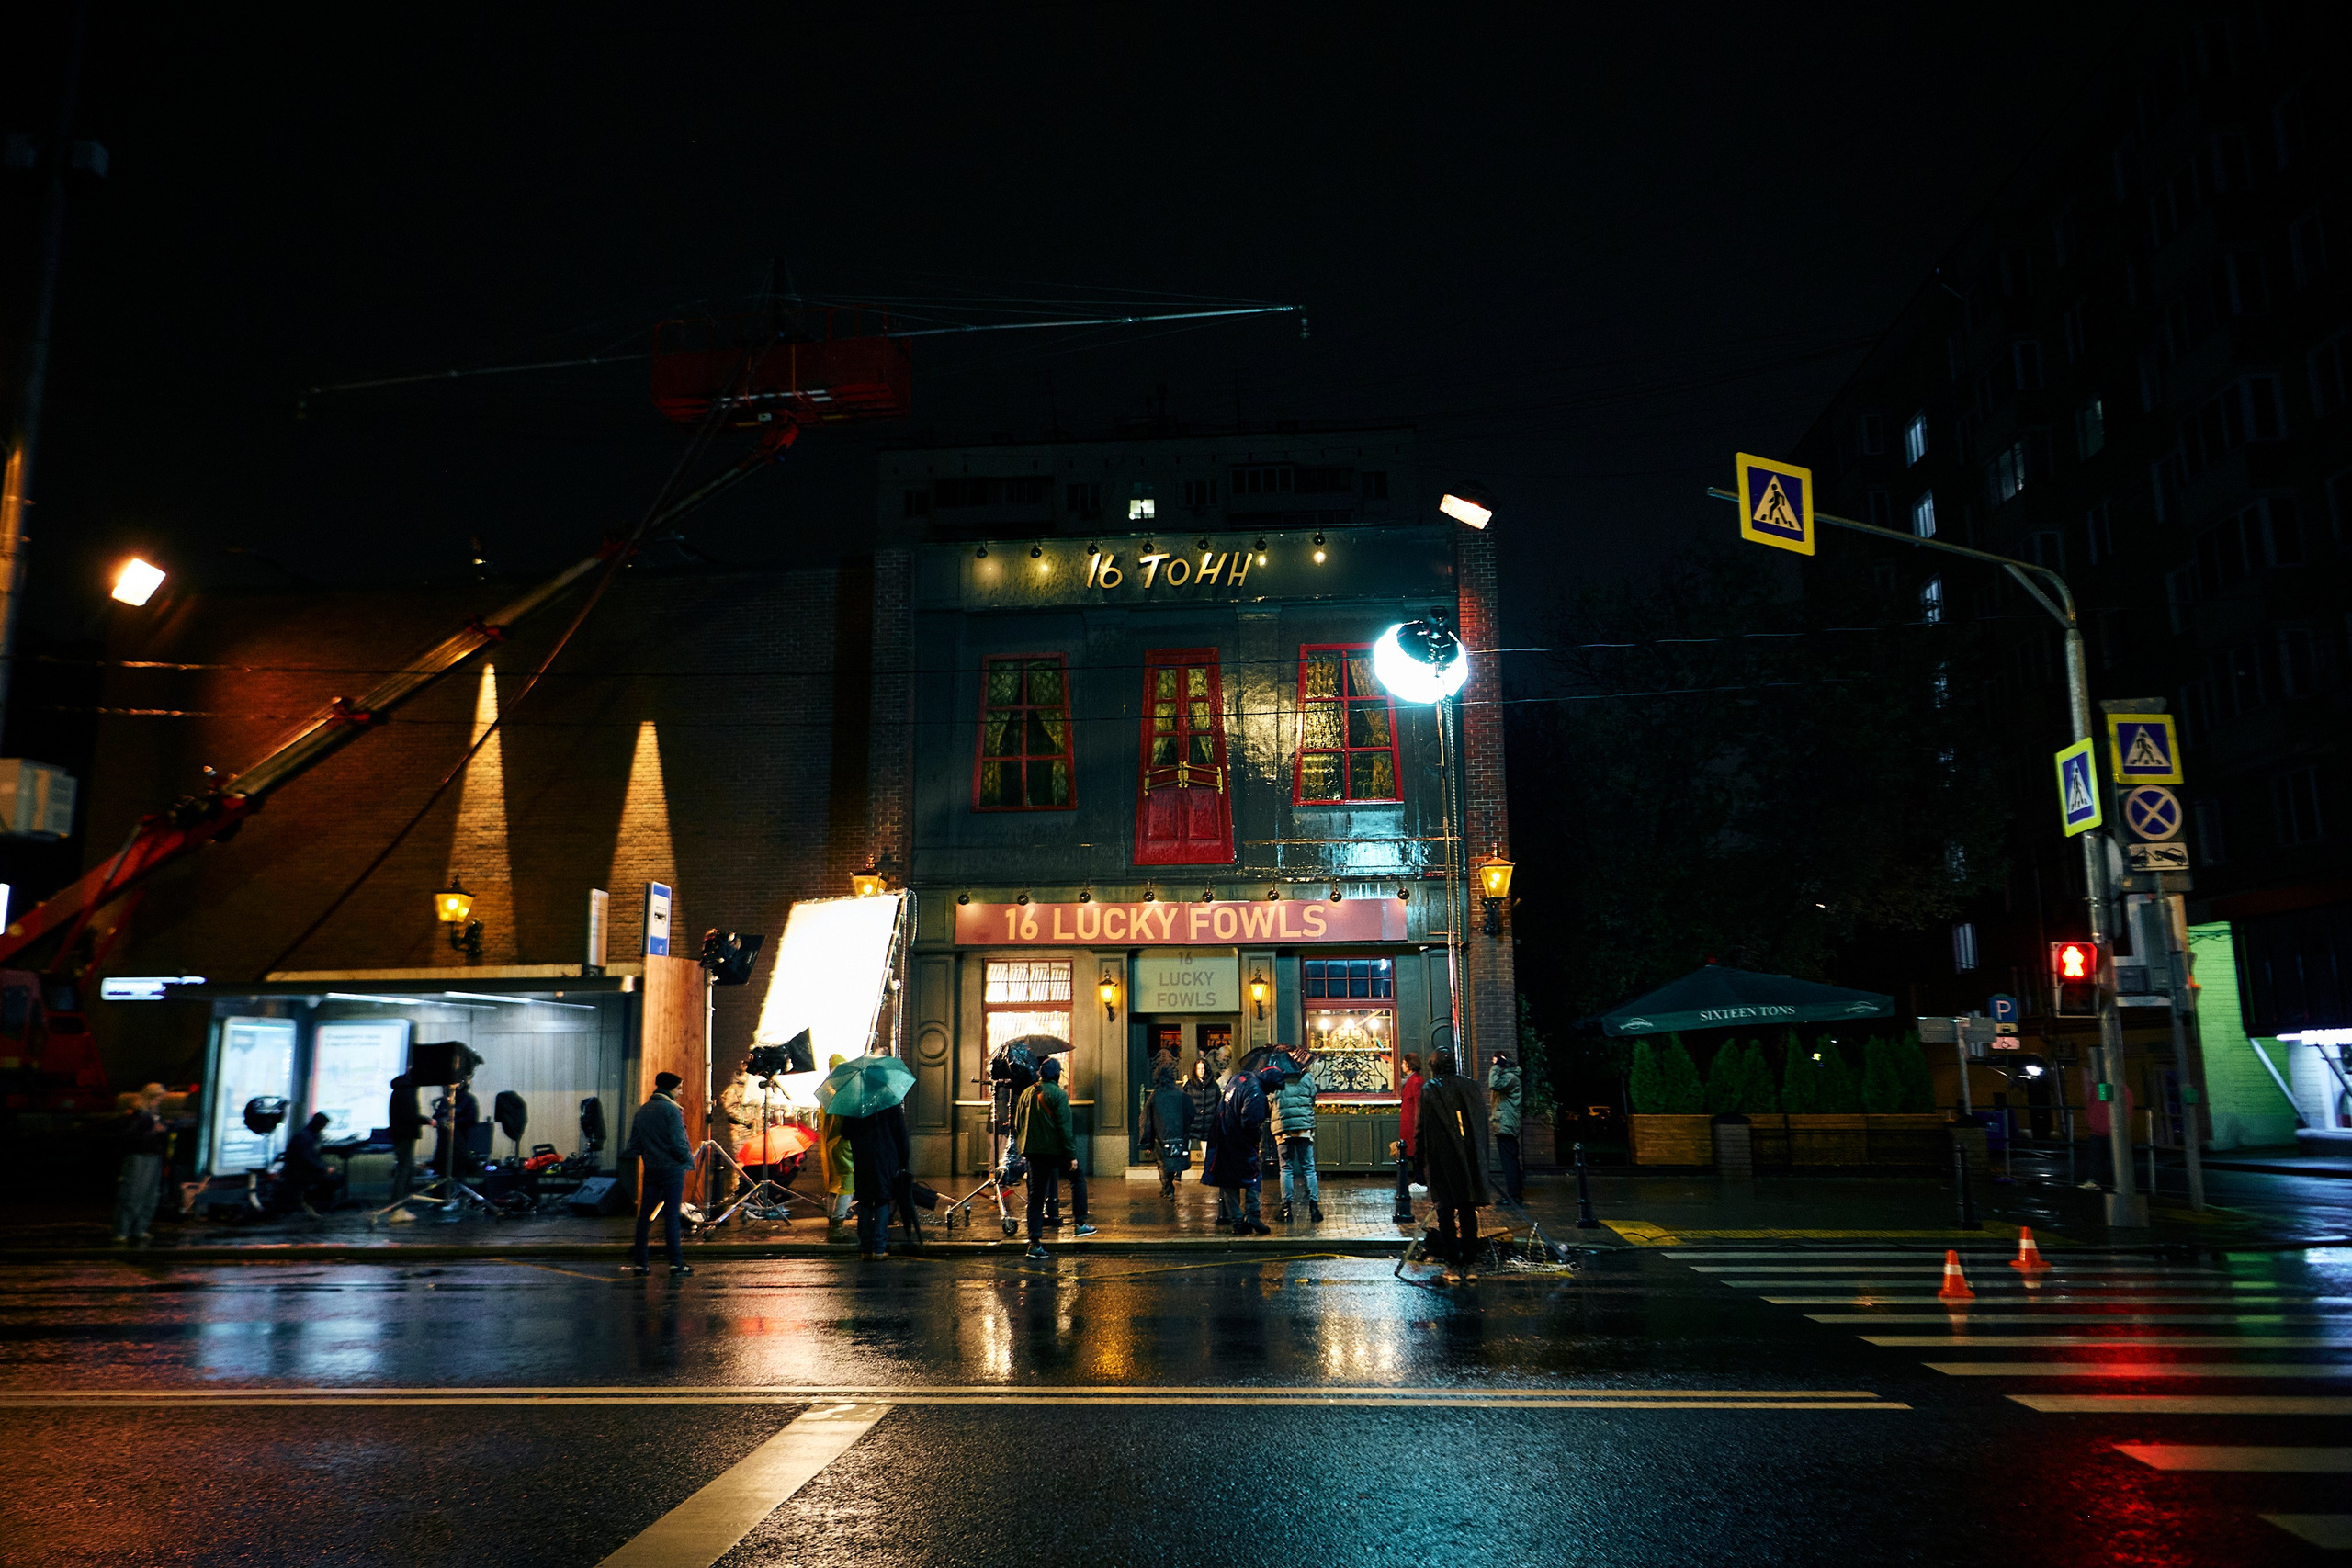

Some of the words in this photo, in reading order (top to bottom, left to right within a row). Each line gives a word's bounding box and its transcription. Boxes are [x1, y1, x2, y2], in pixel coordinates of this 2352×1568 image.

[1087, 553, 1123, 589] 16
[1139, 552, 1253, 589] ТОНН
[1005, 907, 1039, 941] 16
[1053, 907, 1179, 940] LUCKY
[1190, 905, 1327, 940] FOWLS
[1178, 951, 1193, 965] 16
[1159, 971, 1215, 987] LUCKY
[1157, 991, 1216, 1008] FOWLS
[1700, 1007, 1757, 1021] SIXTEEN
[1758, 1005, 1796, 1017] TONS
[1996, 1000, 2011, 1020] P
